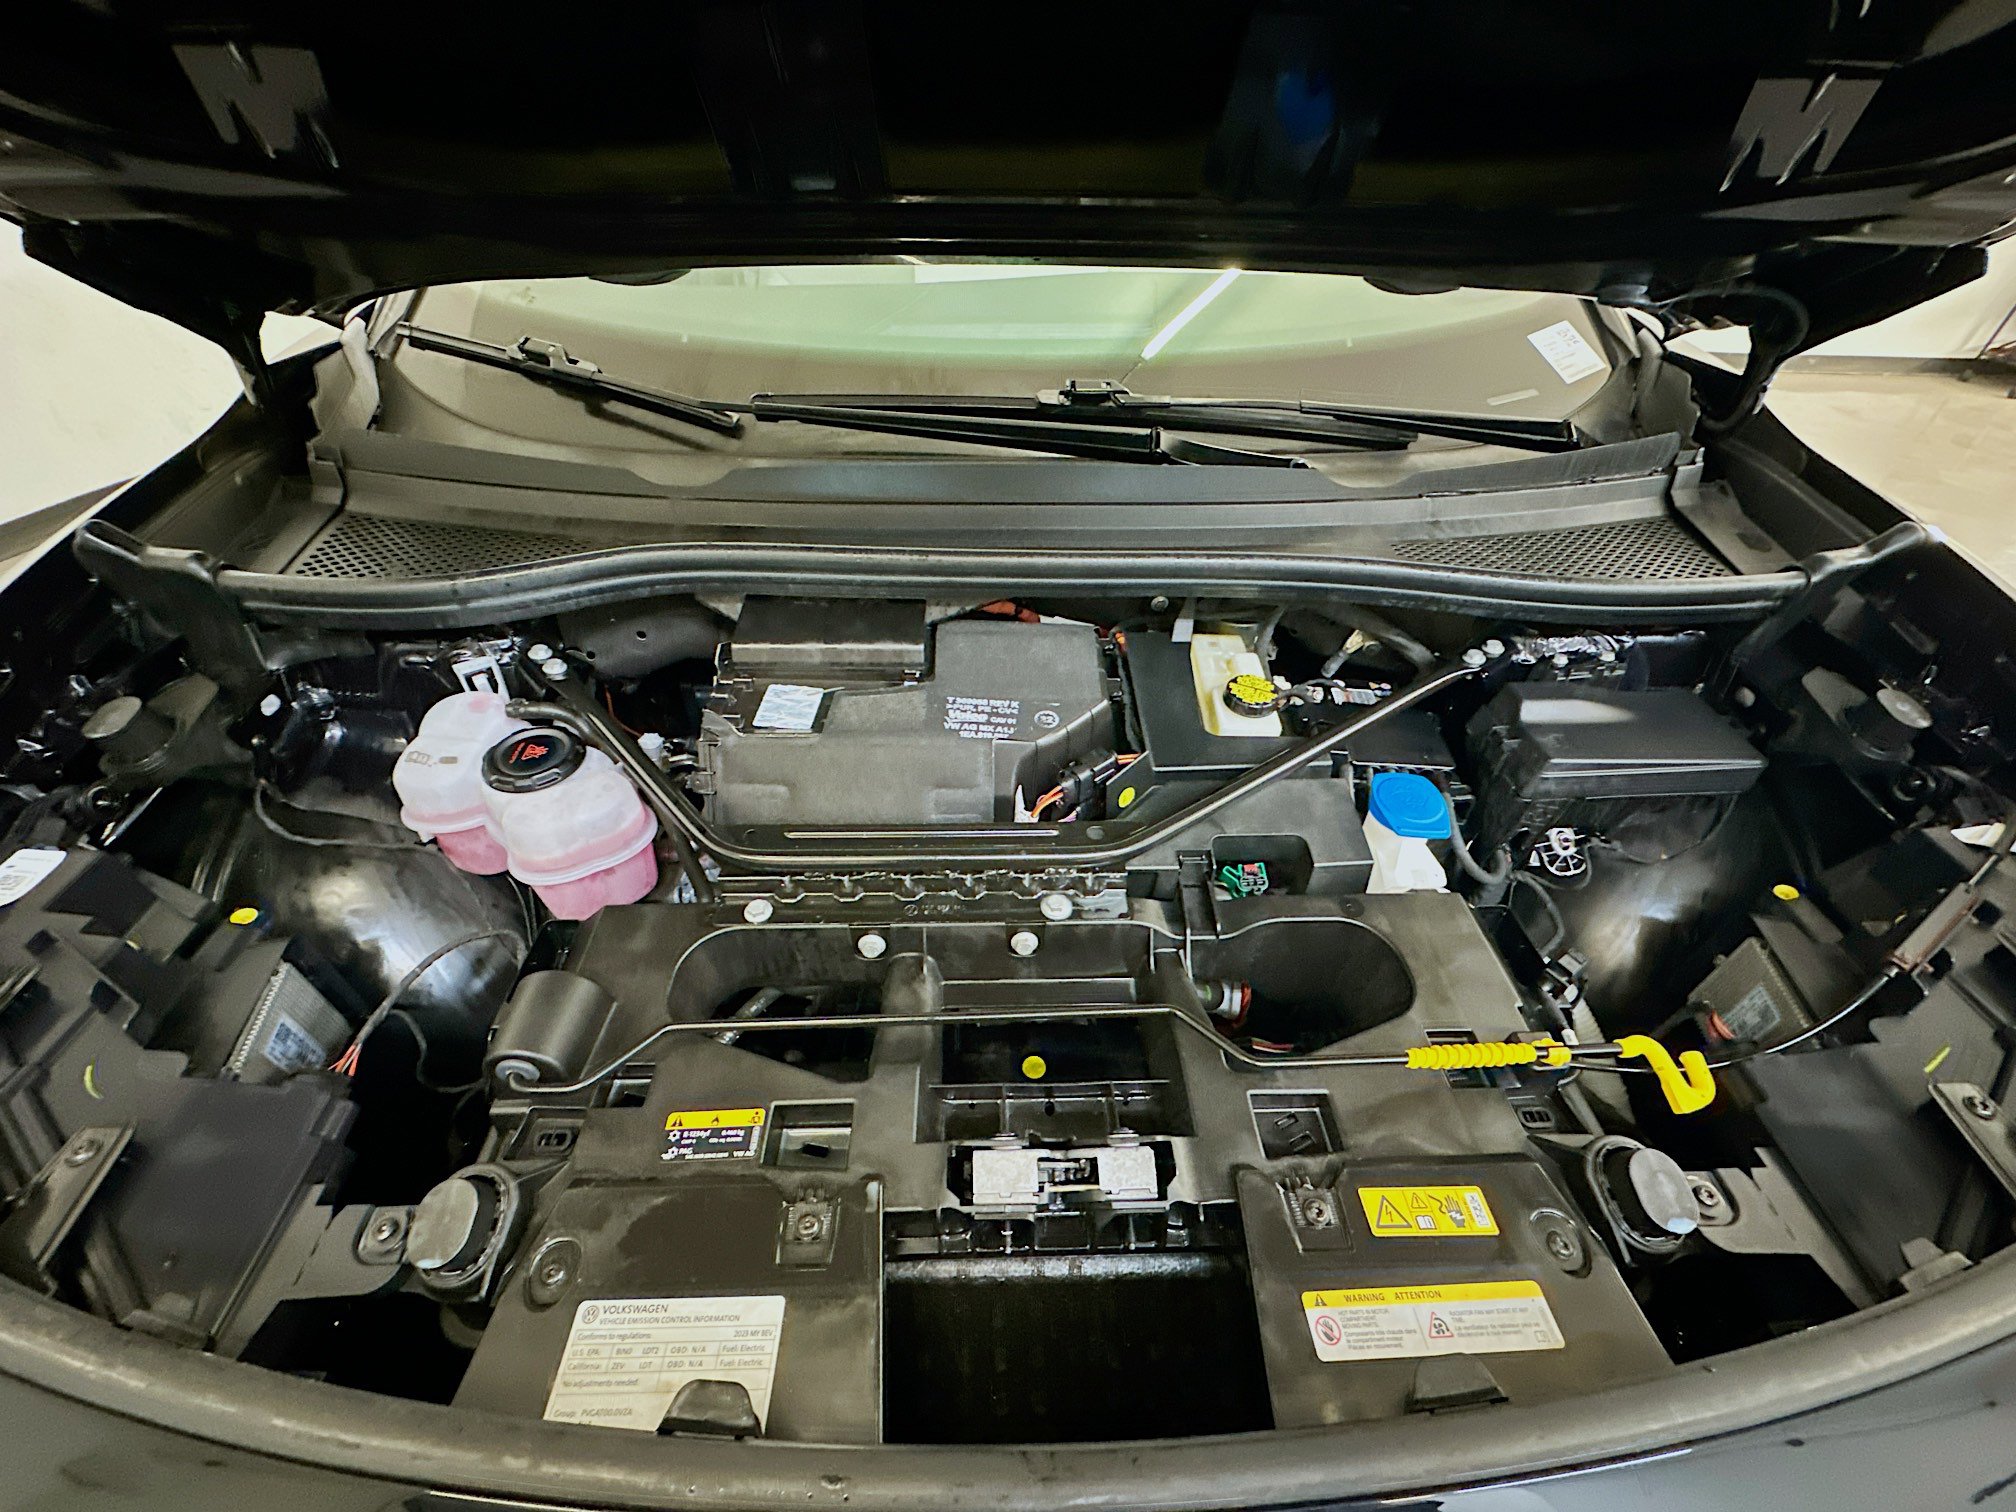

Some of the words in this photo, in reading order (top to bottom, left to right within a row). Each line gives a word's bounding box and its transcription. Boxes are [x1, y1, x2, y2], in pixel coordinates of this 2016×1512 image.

[1344, 1293, 1385, 1302] WARNING
[1394, 1290, 1442, 1300] ATTENTION
[602, 1304, 668, 1315] VOLKSWAGEN
[599, 1316, 626, 1325] VEHICLE
[627, 1316, 660, 1324] EMISSION
[661, 1315, 692, 1324] CONTROL
[693, 1314, 740, 1323] INFORMATION
[642, 1346, 659, 1354] LDT2
[691, 1345, 706, 1353] N/A
[740, 1344, 765, 1352] Electric
[611, 1362, 625, 1370] ZEV
[638, 1361, 652, 1369] LDT
[688, 1360, 703, 1368] N/A
[738, 1358, 763, 1366] Electric
